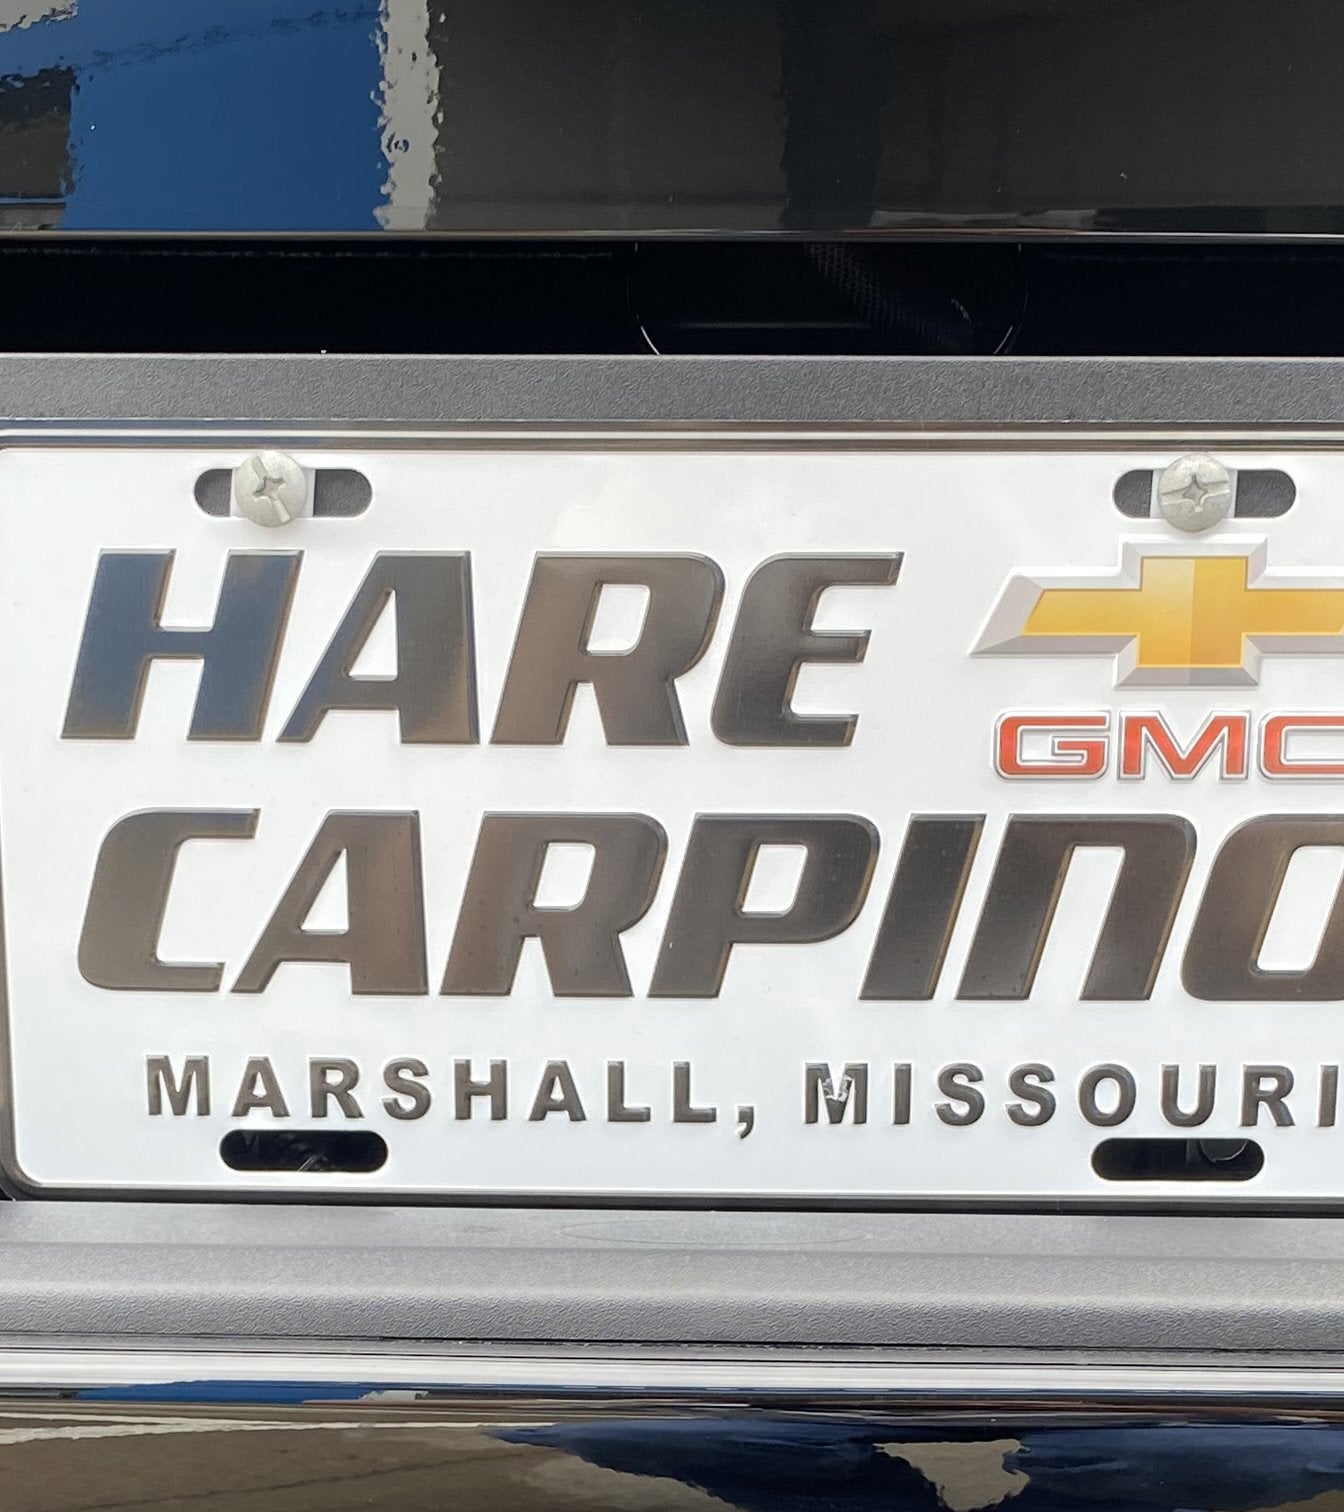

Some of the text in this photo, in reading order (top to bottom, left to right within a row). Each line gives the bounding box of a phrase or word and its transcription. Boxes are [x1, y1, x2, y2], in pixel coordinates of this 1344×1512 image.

[59, 548, 904, 748] HARE
[144, 1054, 1342, 1140] MARSHALL, MISSOURI
